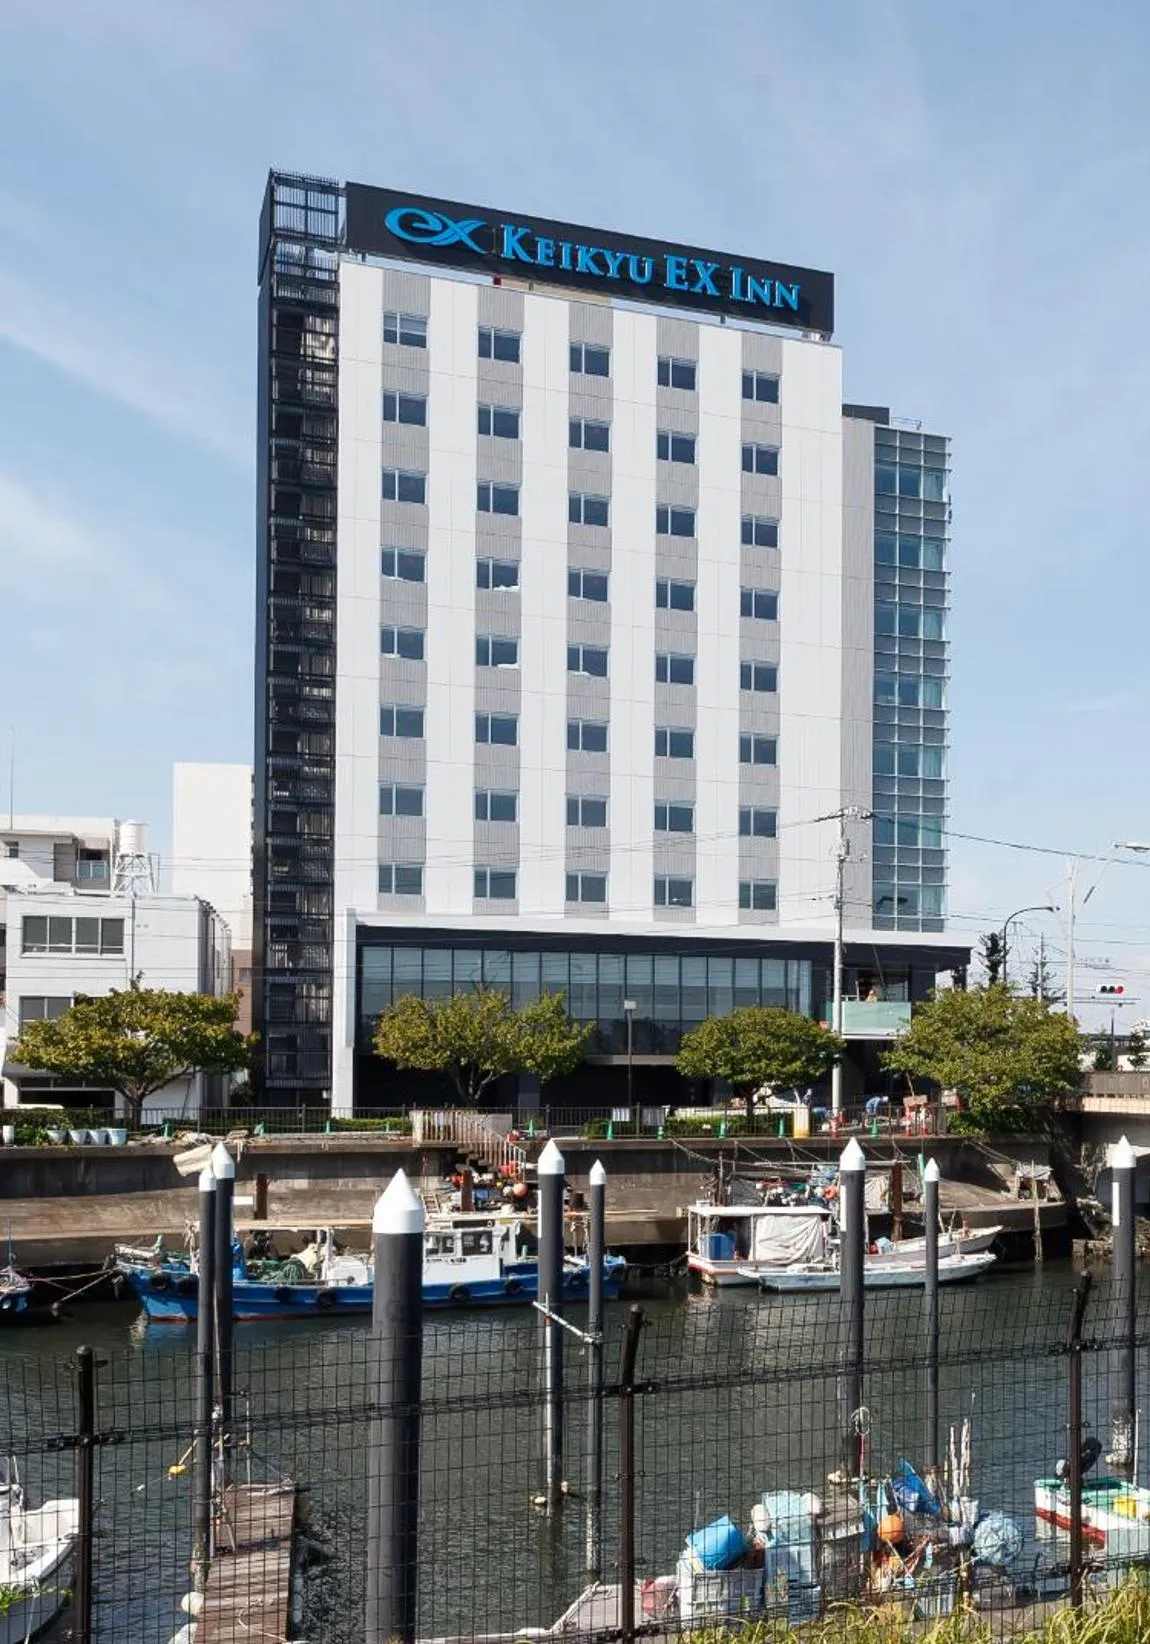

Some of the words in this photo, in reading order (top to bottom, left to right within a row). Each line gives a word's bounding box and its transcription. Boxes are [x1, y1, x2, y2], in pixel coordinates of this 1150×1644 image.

[501, 223, 655, 284] KEIKYU
[664, 254, 721, 296] EX
[729, 266, 801, 310] INN
